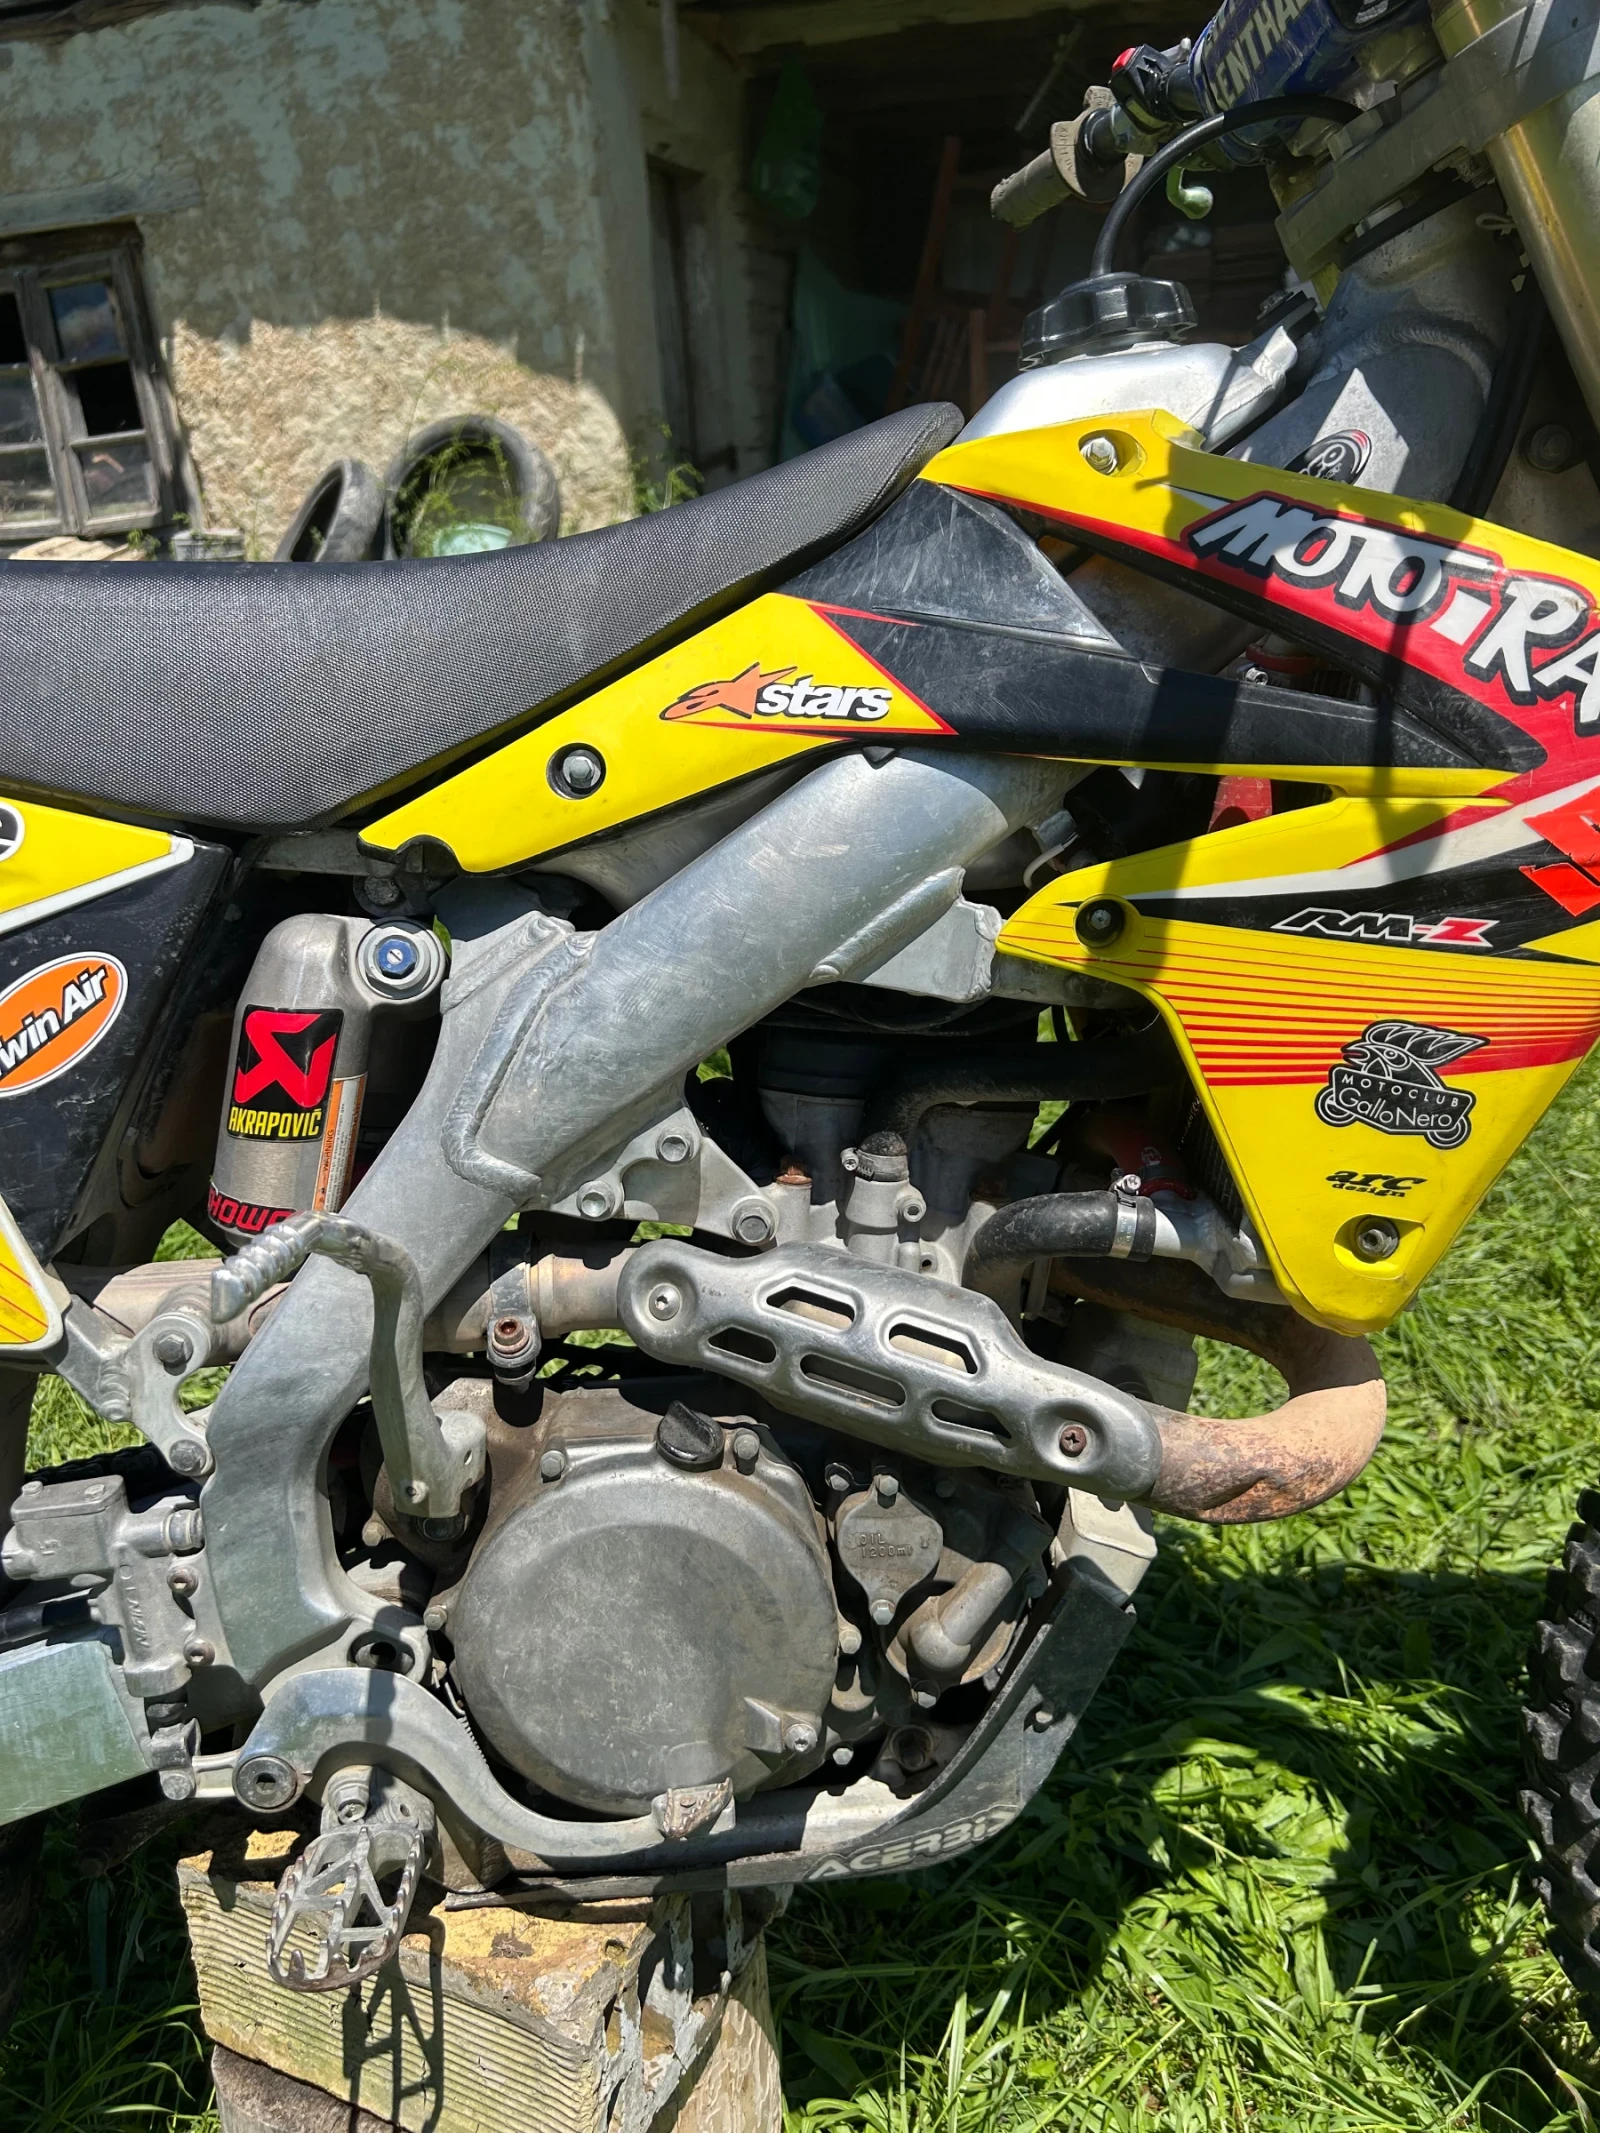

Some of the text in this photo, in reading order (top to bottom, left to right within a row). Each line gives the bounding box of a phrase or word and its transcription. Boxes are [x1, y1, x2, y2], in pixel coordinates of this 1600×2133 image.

[1270, 907, 1500, 947] RM-Z
[0, 967, 107, 1076] win Air
[1341, 1073, 1459, 1107] MOTOCLUB
[1325, 1170, 1428, 1190] arc
[1331, 1182, 1406, 1198] design
[208, 1187, 294, 1232] HOW
[859, 1533, 886, 1545] OIL
